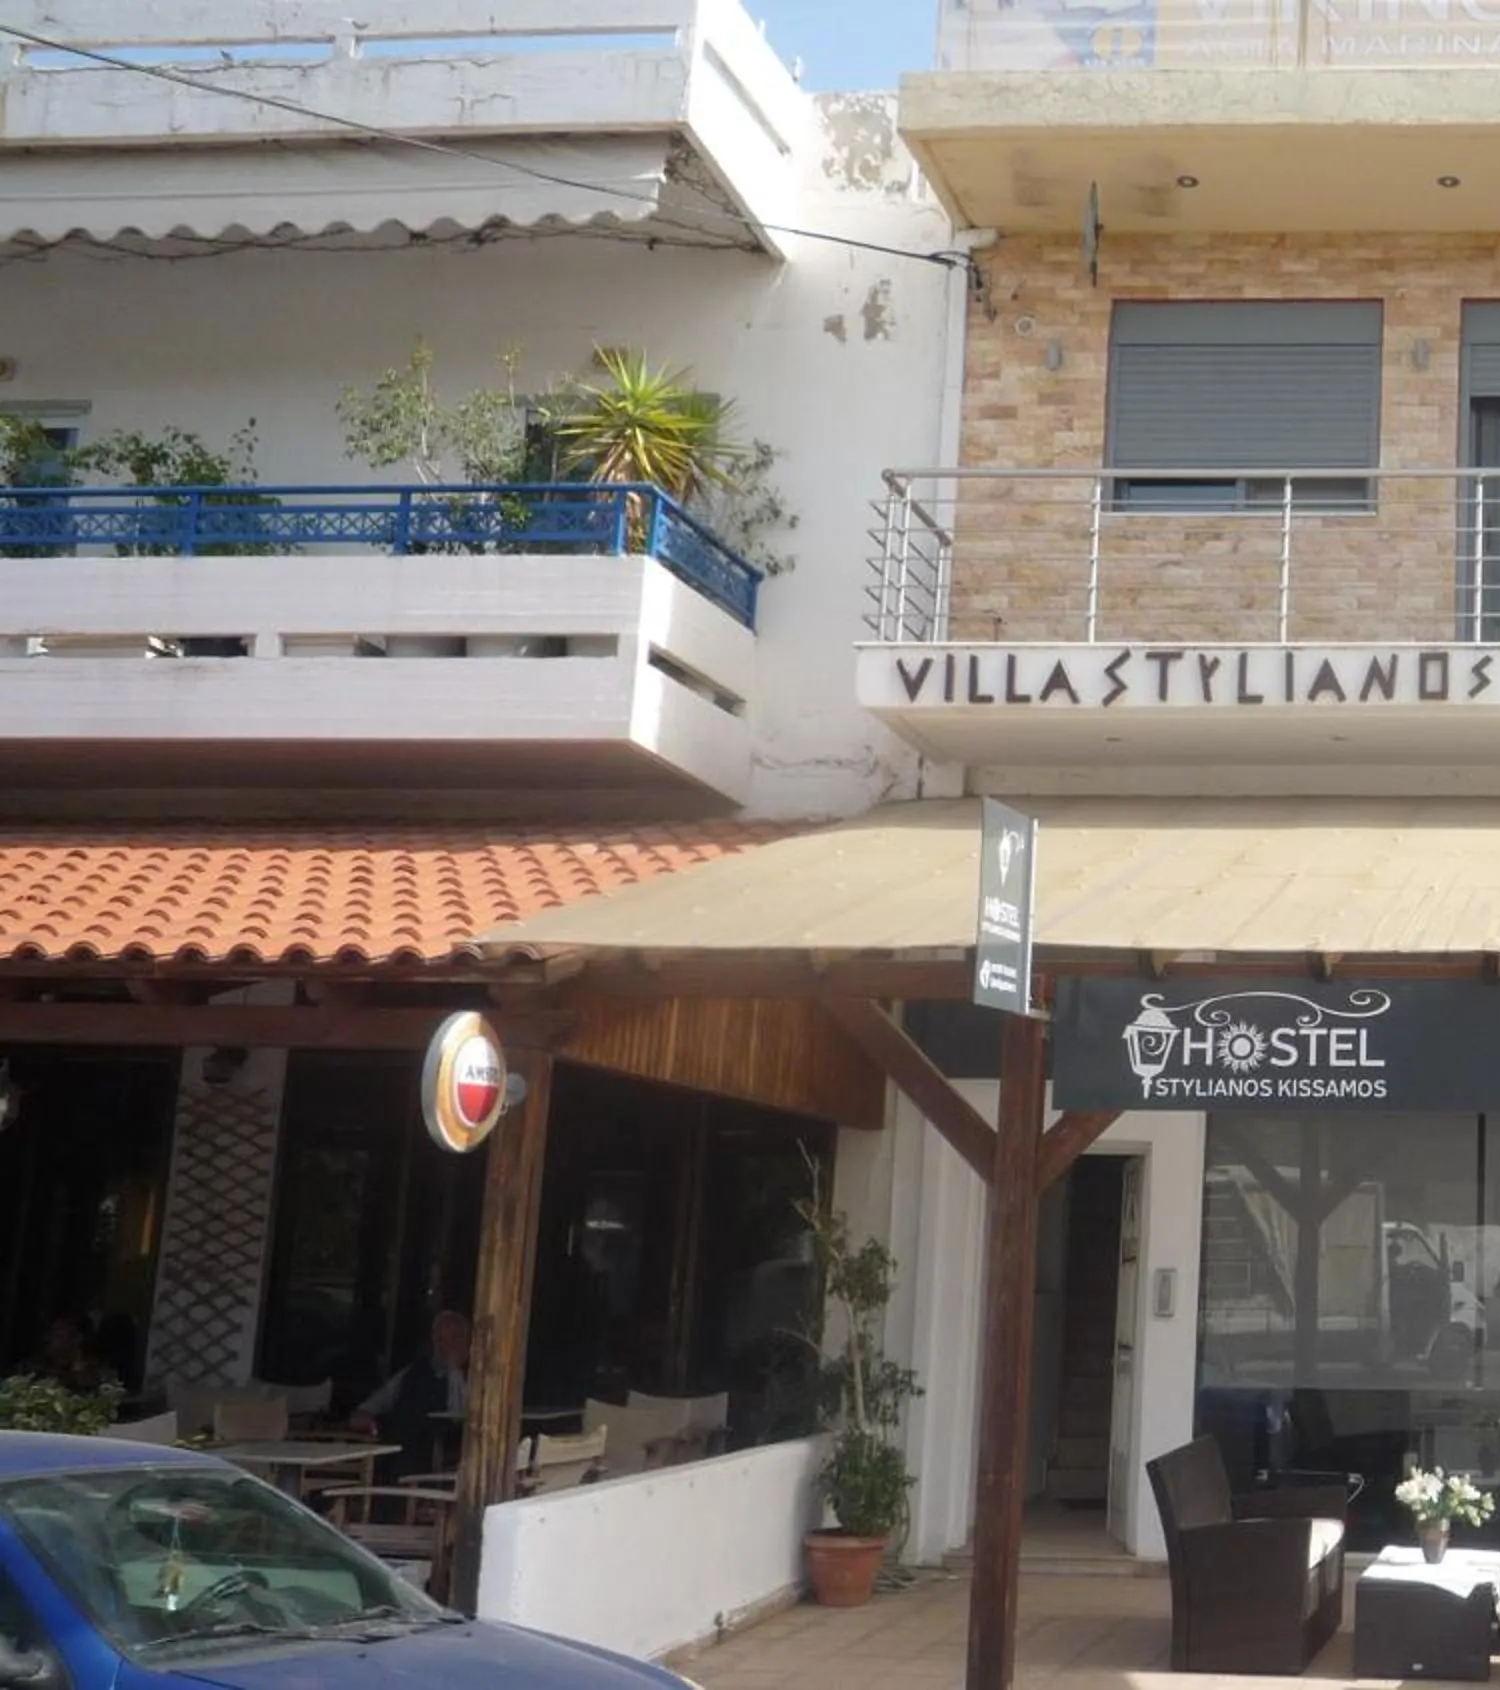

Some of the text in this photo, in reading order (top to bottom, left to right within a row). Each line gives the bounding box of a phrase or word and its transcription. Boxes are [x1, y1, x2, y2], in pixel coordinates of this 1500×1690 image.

[896, 649, 1494, 707] VILLA STYLIANOS
[1183, 1025, 1385, 1069] HOSTEL
[1155, 1079, 1388, 1099] STYLIANOS KISSAMOS
